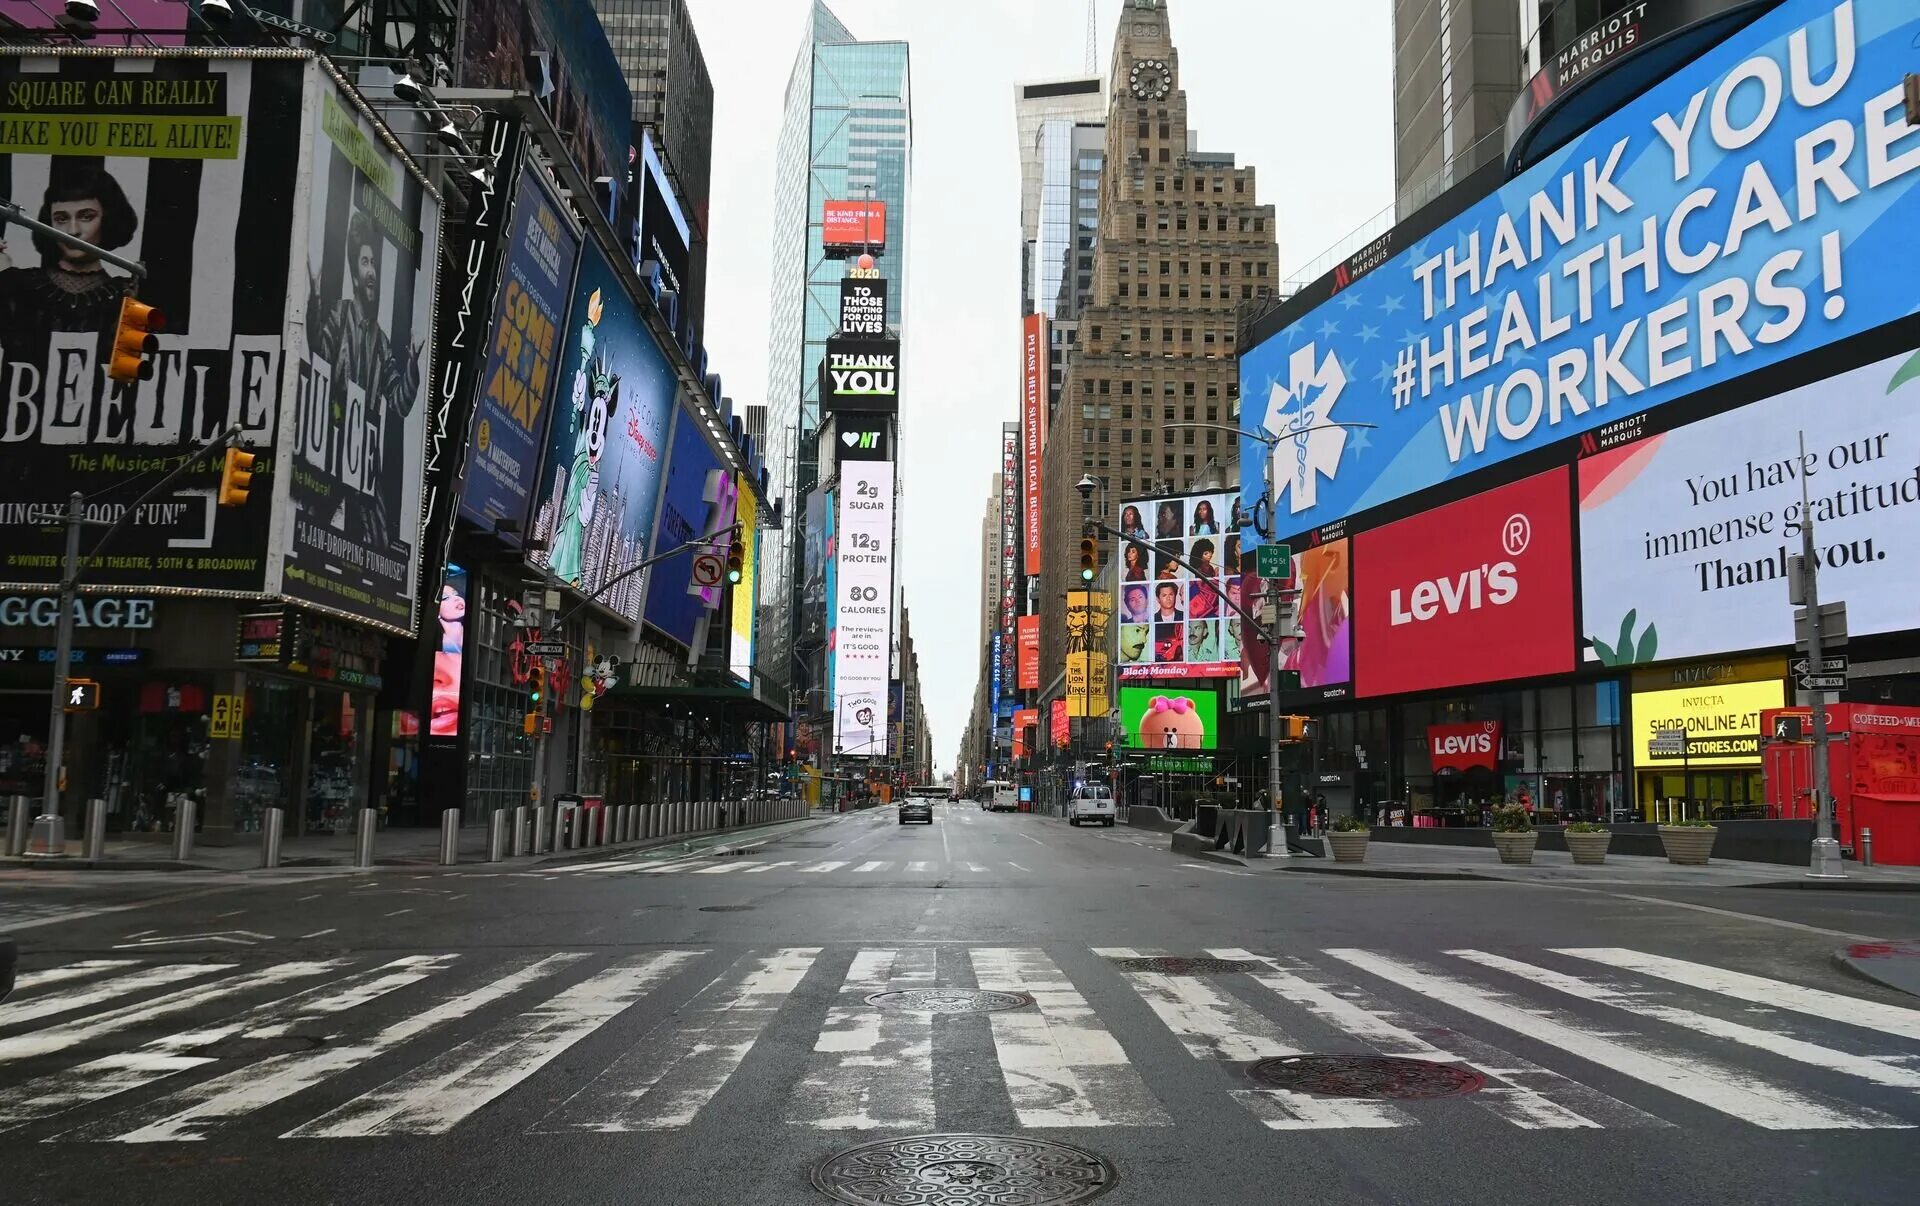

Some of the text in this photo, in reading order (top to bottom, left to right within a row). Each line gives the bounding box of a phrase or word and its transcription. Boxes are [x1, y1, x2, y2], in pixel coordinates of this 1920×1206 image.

[255, 10, 328, 41] LAMAR
[1558, 2, 1648, 68] MARRIOTT
[1558, 29, 1638, 88] MARQUIS
[7, 79, 219, 107] SQUARE CAN REALLY
[58, 120, 99, 147] YOU
[106, 122, 158, 148] FEEL
[165, 123, 233, 150] ALIVE!
[1412, 0, 1857, 322] THANK YOU
[361, 183, 417, 254] ON BROADWAY!
[1351, 232, 1394, 267] MARRIOTT
[1391, 83, 1920, 411] #HEALTHCARE
[510, 261, 527, 286] COME
[849, 268, 880, 279] 2020
[1351, 249, 1388, 279] MARQUIS
[853, 286, 872, 297] TO
[843, 296, 884, 307] THOSE
[843, 306, 883, 314] FIGHTING
[503, 278, 556, 360] COME
[843, 313, 883, 322] FOR OUR
[842, 321, 883, 334] LIVES
[1439, 229, 1847, 465] WORKERS!
[830, 353, 895, 368] THANK
[830, 370, 896, 395] YOU
[0, 345, 271, 446] BEETLE
[486, 360, 543, 434] AWAY
[293, 364, 379, 497] JUICE
[1600, 413, 1648, 437] MARRIOTT
[1027, 333, 1039, 553] PLEASE HELP SUPPORT LOCAL BUSINESS.
[1600, 427, 1642, 448] MARQUIS
[69, 453, 97, 473] The
[1684, 431, 1890, 507] You have our
[856, 480, 879, 499] 2g
[849, 501, 885, 510] SUGAR
[1321, 519, 1347, 534] MARRIOTT
[1321, 529, 1344, 542] MARQUIS
[1644, 510, 1774, 561] immense
[306, 526, 365, 567] JAW-DROPPING
[851, 533, 881, 552] 12g
[1268, 548, 1278, 556] TO
[17, 555, 258, 571] WINTER THEATRE, 50TH & BROADWAY
[842, 554, 887, 564] PROTEIN
[1261, 557, 1287, 565] W 45 St
[849, 586, 878, 602] 80
[840, 606, 887, 615] CALORIES
[842, 643, 857, 651] IT'S
[339, 669, 364, 684] SONY
[1068, 675, 1084, 684] LION
[1070, 667, 1081, 675] THE
[1122, 665, 1189, 676] Black Monday
[1672, 664, 1735, 684] INVICTA
[1067, 684, 1086, 696] KING
[1804, 678, 1840, 686] ONE WAY
[847, 698, 862, 708] TWO
[1682, 695, 1725, 708] INVICTA
[214, 697, 227, 732] ATM
[1650, 717, 1685, 735] SHOP
[1686, 713, 1738, 733] ONLINE
[1740, 712, 1759, 729] AT
[1853, 713, 1899, 726] COFFEED
